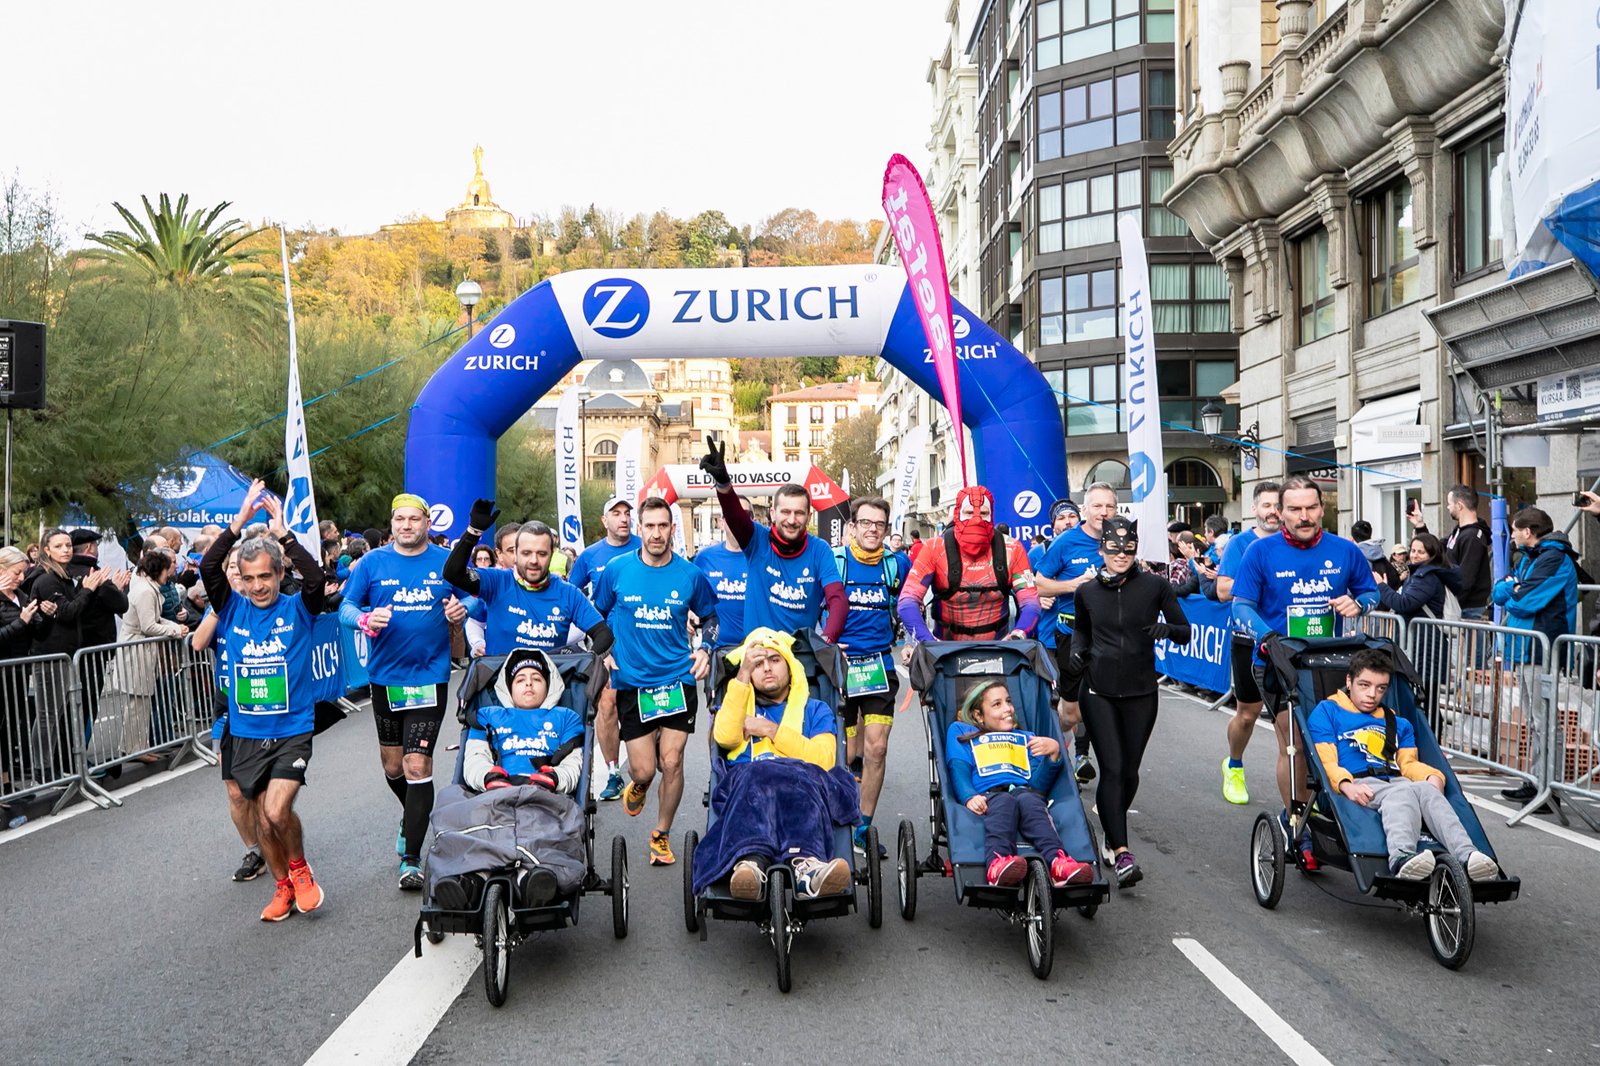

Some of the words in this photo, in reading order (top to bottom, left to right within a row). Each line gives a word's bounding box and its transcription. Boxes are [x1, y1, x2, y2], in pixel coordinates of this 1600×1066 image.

[672, 285, 859, 323] ZURICH
[463, 354, 539, 371] ZURICH
[923, 344, 997, 364] ZRICH
[563, 426, 576, 505] ZURICH
[625, 459, 636, 500] URICH
[687, 474, 701, 485] EL
[749, 471, 792, 484] VASCO
[810, 482, 830, 496] DV
[1009, 523, 1055, 541] URIC
[250, 667, 277, 676] ZURICH
[991, 735, 1018, 743] ZURICH
